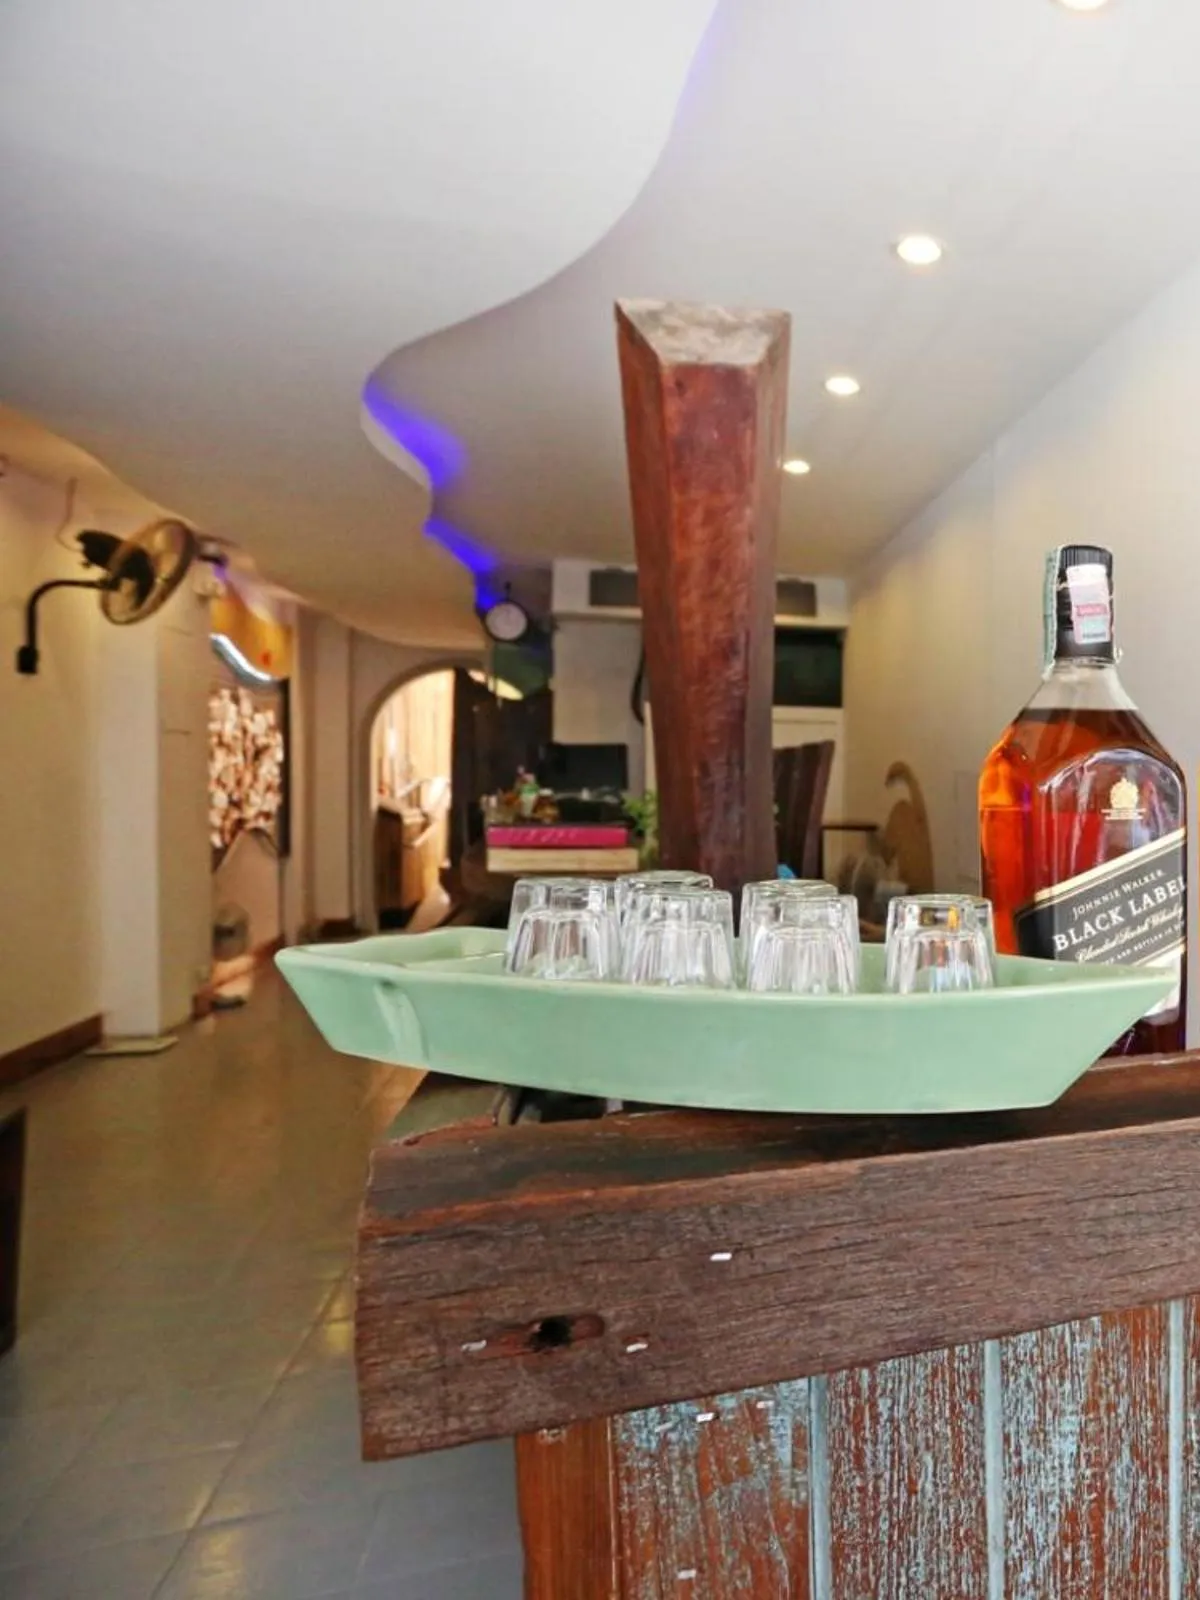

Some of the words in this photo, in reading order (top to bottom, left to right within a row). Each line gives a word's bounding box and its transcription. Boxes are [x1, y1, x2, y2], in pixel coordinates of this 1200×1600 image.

[1052, 905, 1125, 952] BLACK
[1127, 875, 1186, 917] LABEL
[1072, 888, 1121, 920] JOHNNIE
[1120, 868, 1165, 894] WALKER
